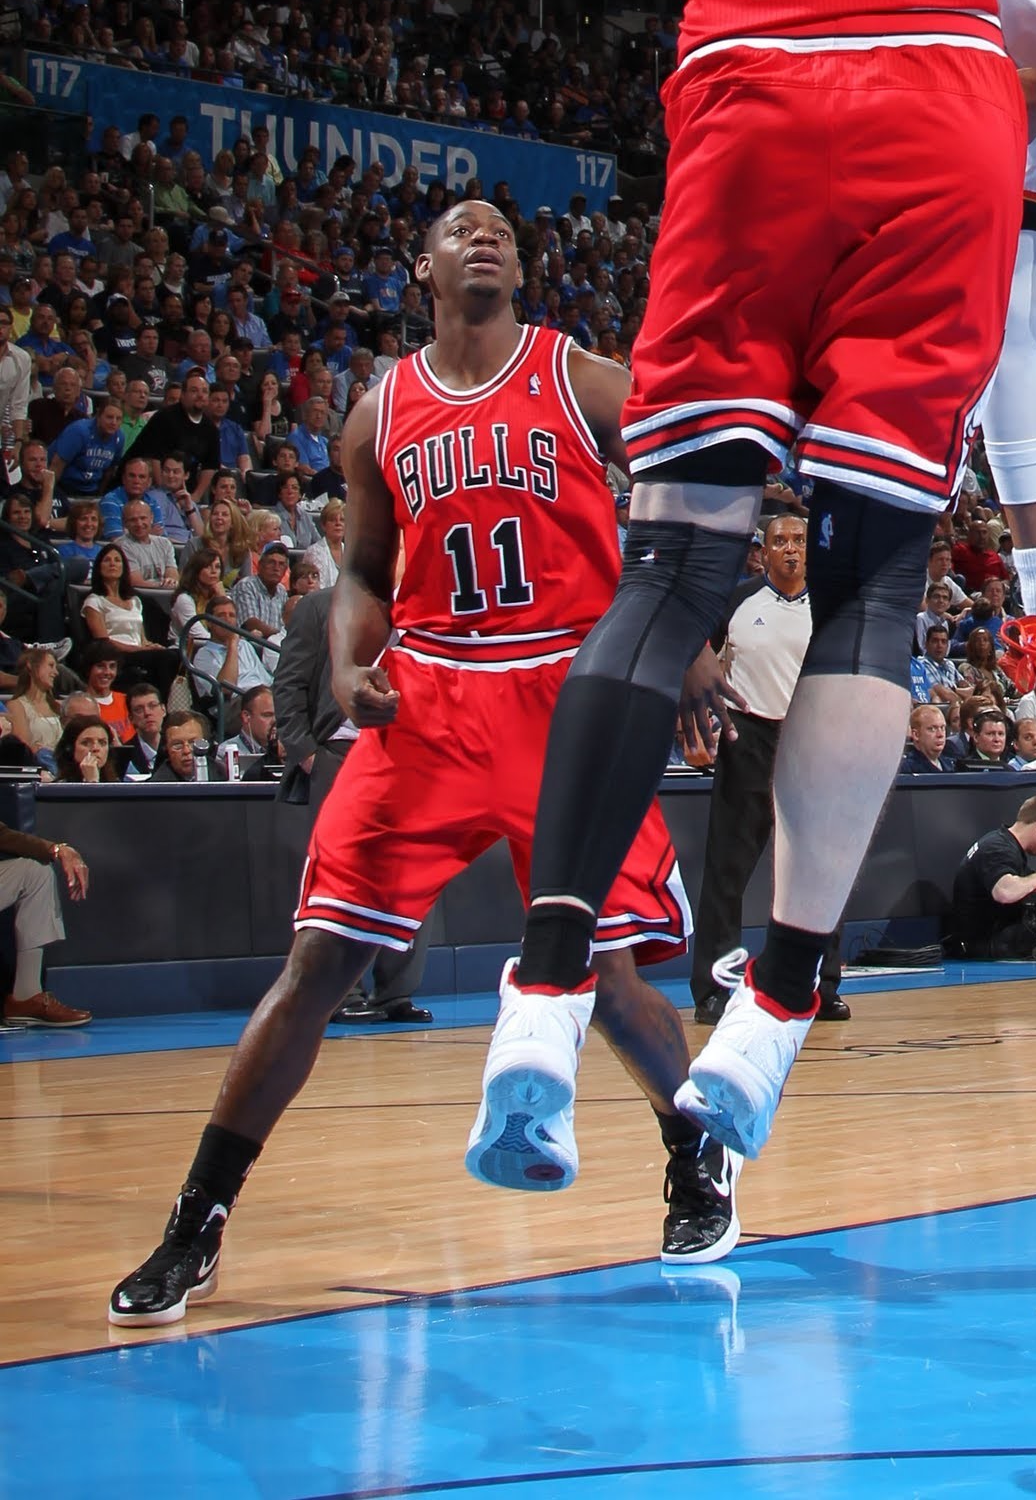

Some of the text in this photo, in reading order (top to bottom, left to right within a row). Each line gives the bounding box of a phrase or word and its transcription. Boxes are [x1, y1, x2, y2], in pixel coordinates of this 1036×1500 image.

[31, 58, 81, 98] 117
[200, 102, 478, 193] THUNDER
[576, 154, 614, 188] 117
[394, 423, 559, 523] BULLS
[443, 516, 535, 616] 11
